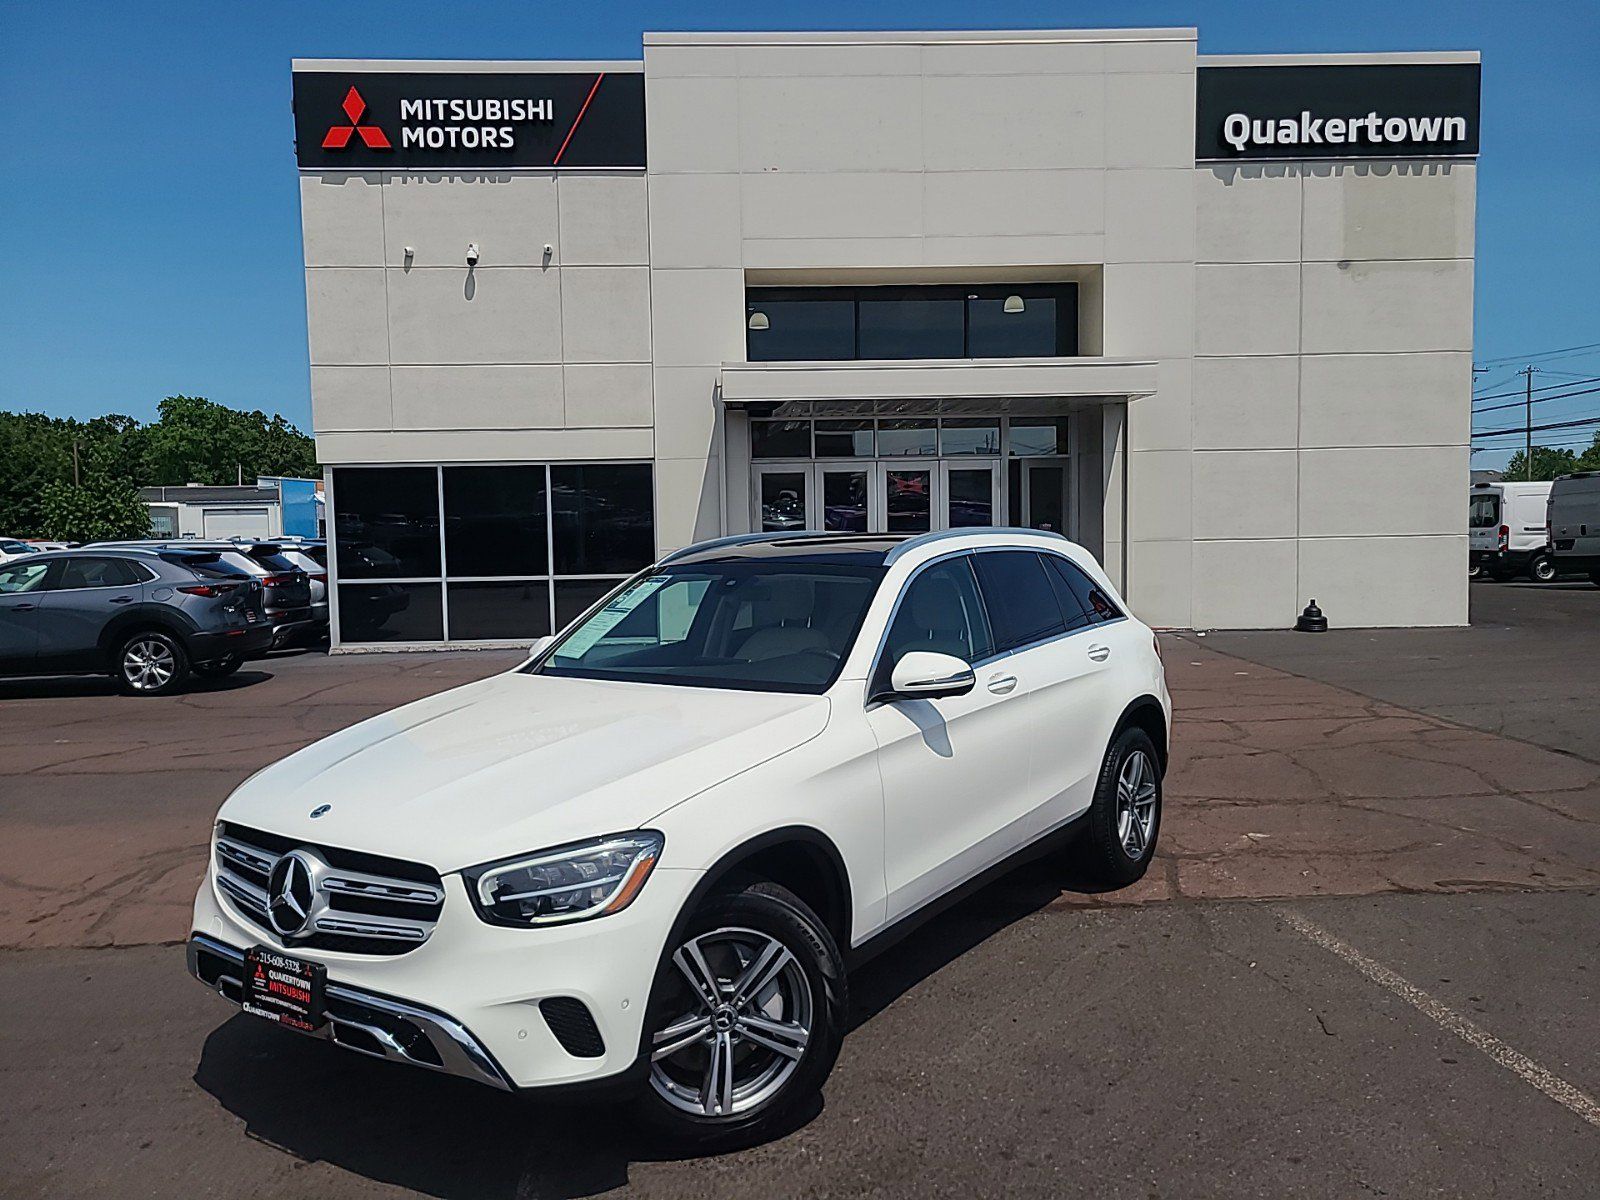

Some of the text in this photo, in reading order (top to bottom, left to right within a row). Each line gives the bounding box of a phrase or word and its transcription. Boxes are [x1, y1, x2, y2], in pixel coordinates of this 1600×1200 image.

[400, 98, 554, 121] MITSUBISHI
[401, 126, 514, 149] MOTORS
[1223, 110, 1466, 151] Quakertown
[268, 970, 311, 991] QUAKERTOWN
[269, 980, 311, 1004] MITSUBISHI
